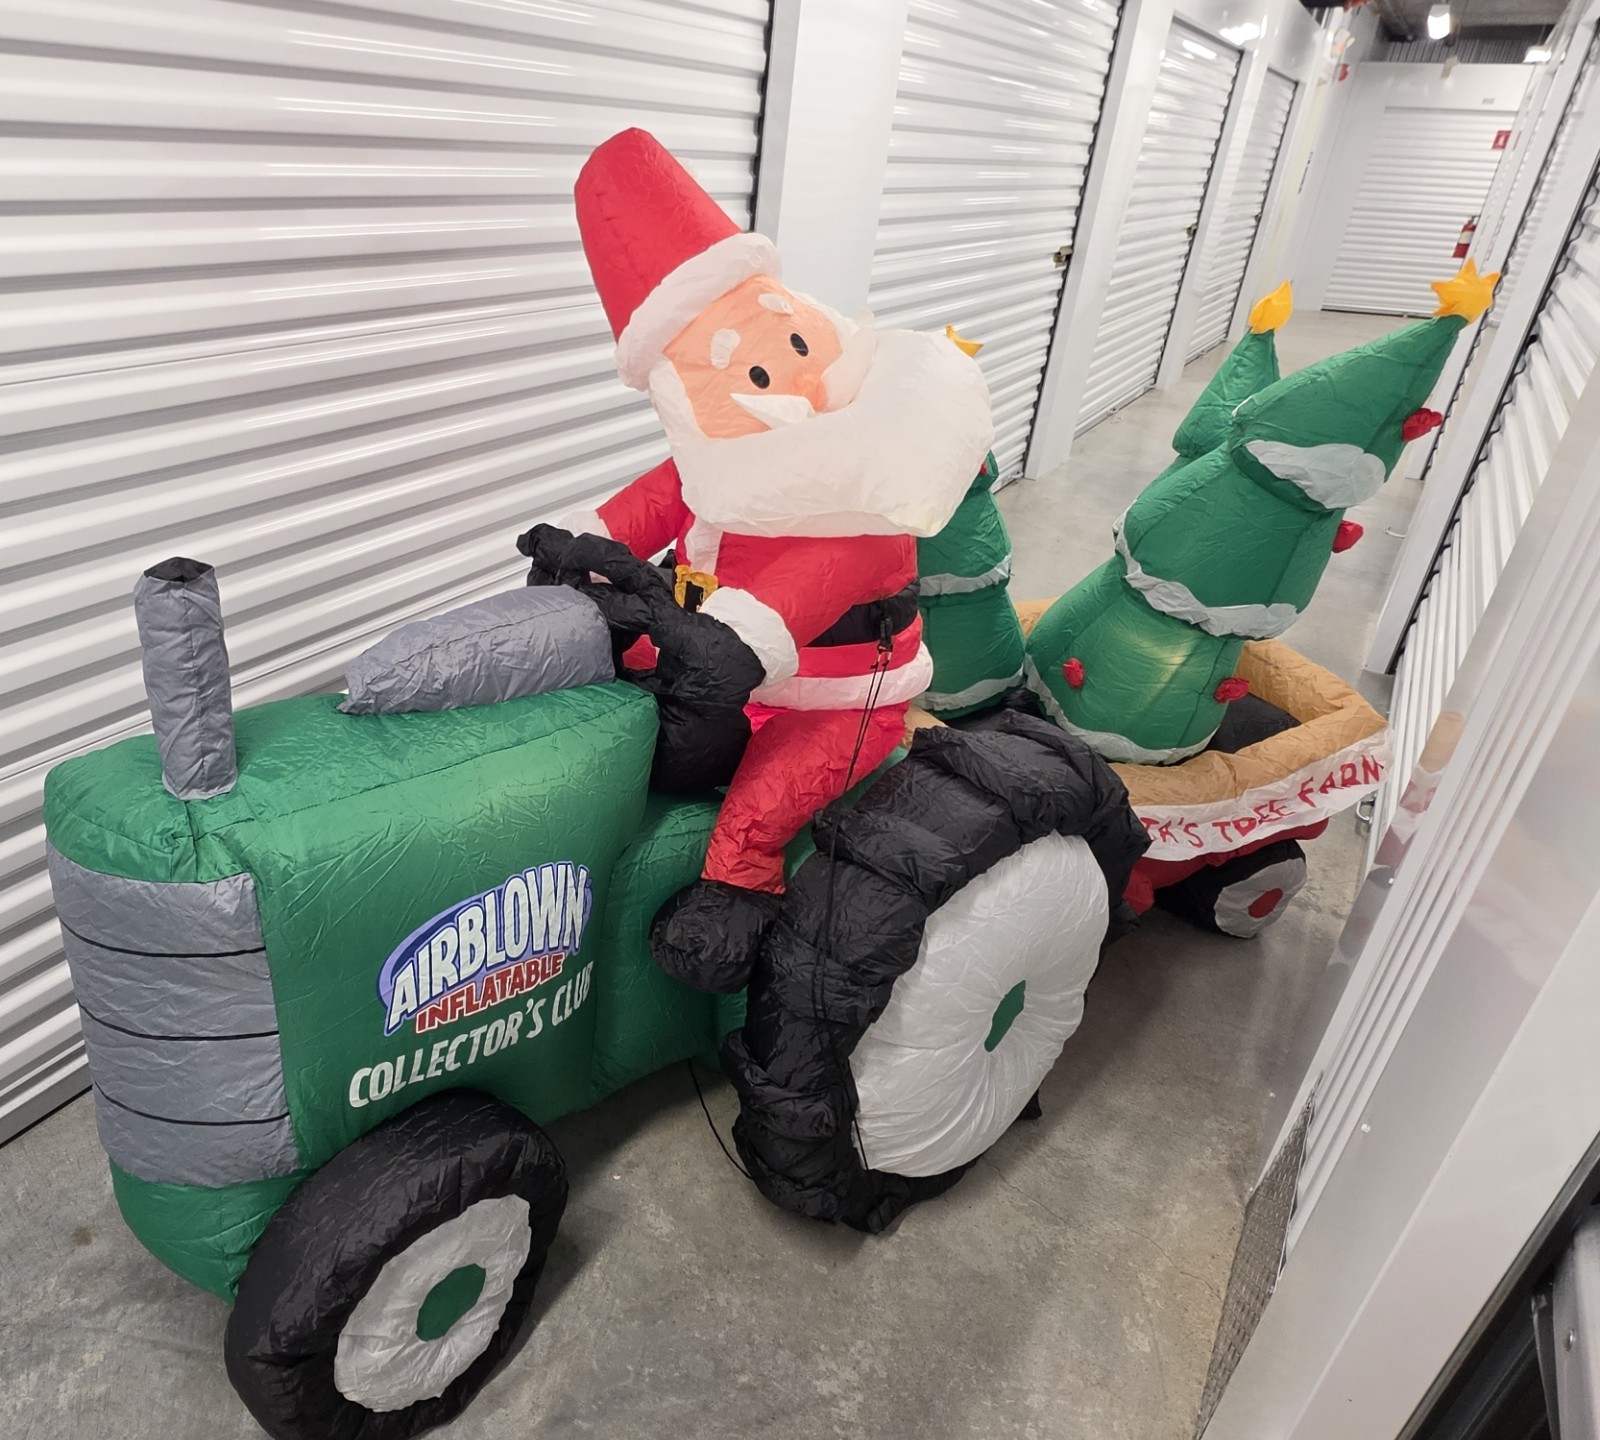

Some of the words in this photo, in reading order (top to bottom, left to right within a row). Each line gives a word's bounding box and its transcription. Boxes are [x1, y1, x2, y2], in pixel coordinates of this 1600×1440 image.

[385, 862, 588, 1033] AIRBLOWN
[416, 952, 565, 1033] INFLATABLE
[349, 997, 547, 1108] COLLECTOR'S
[551, 960, 595, 1027] CLUB
